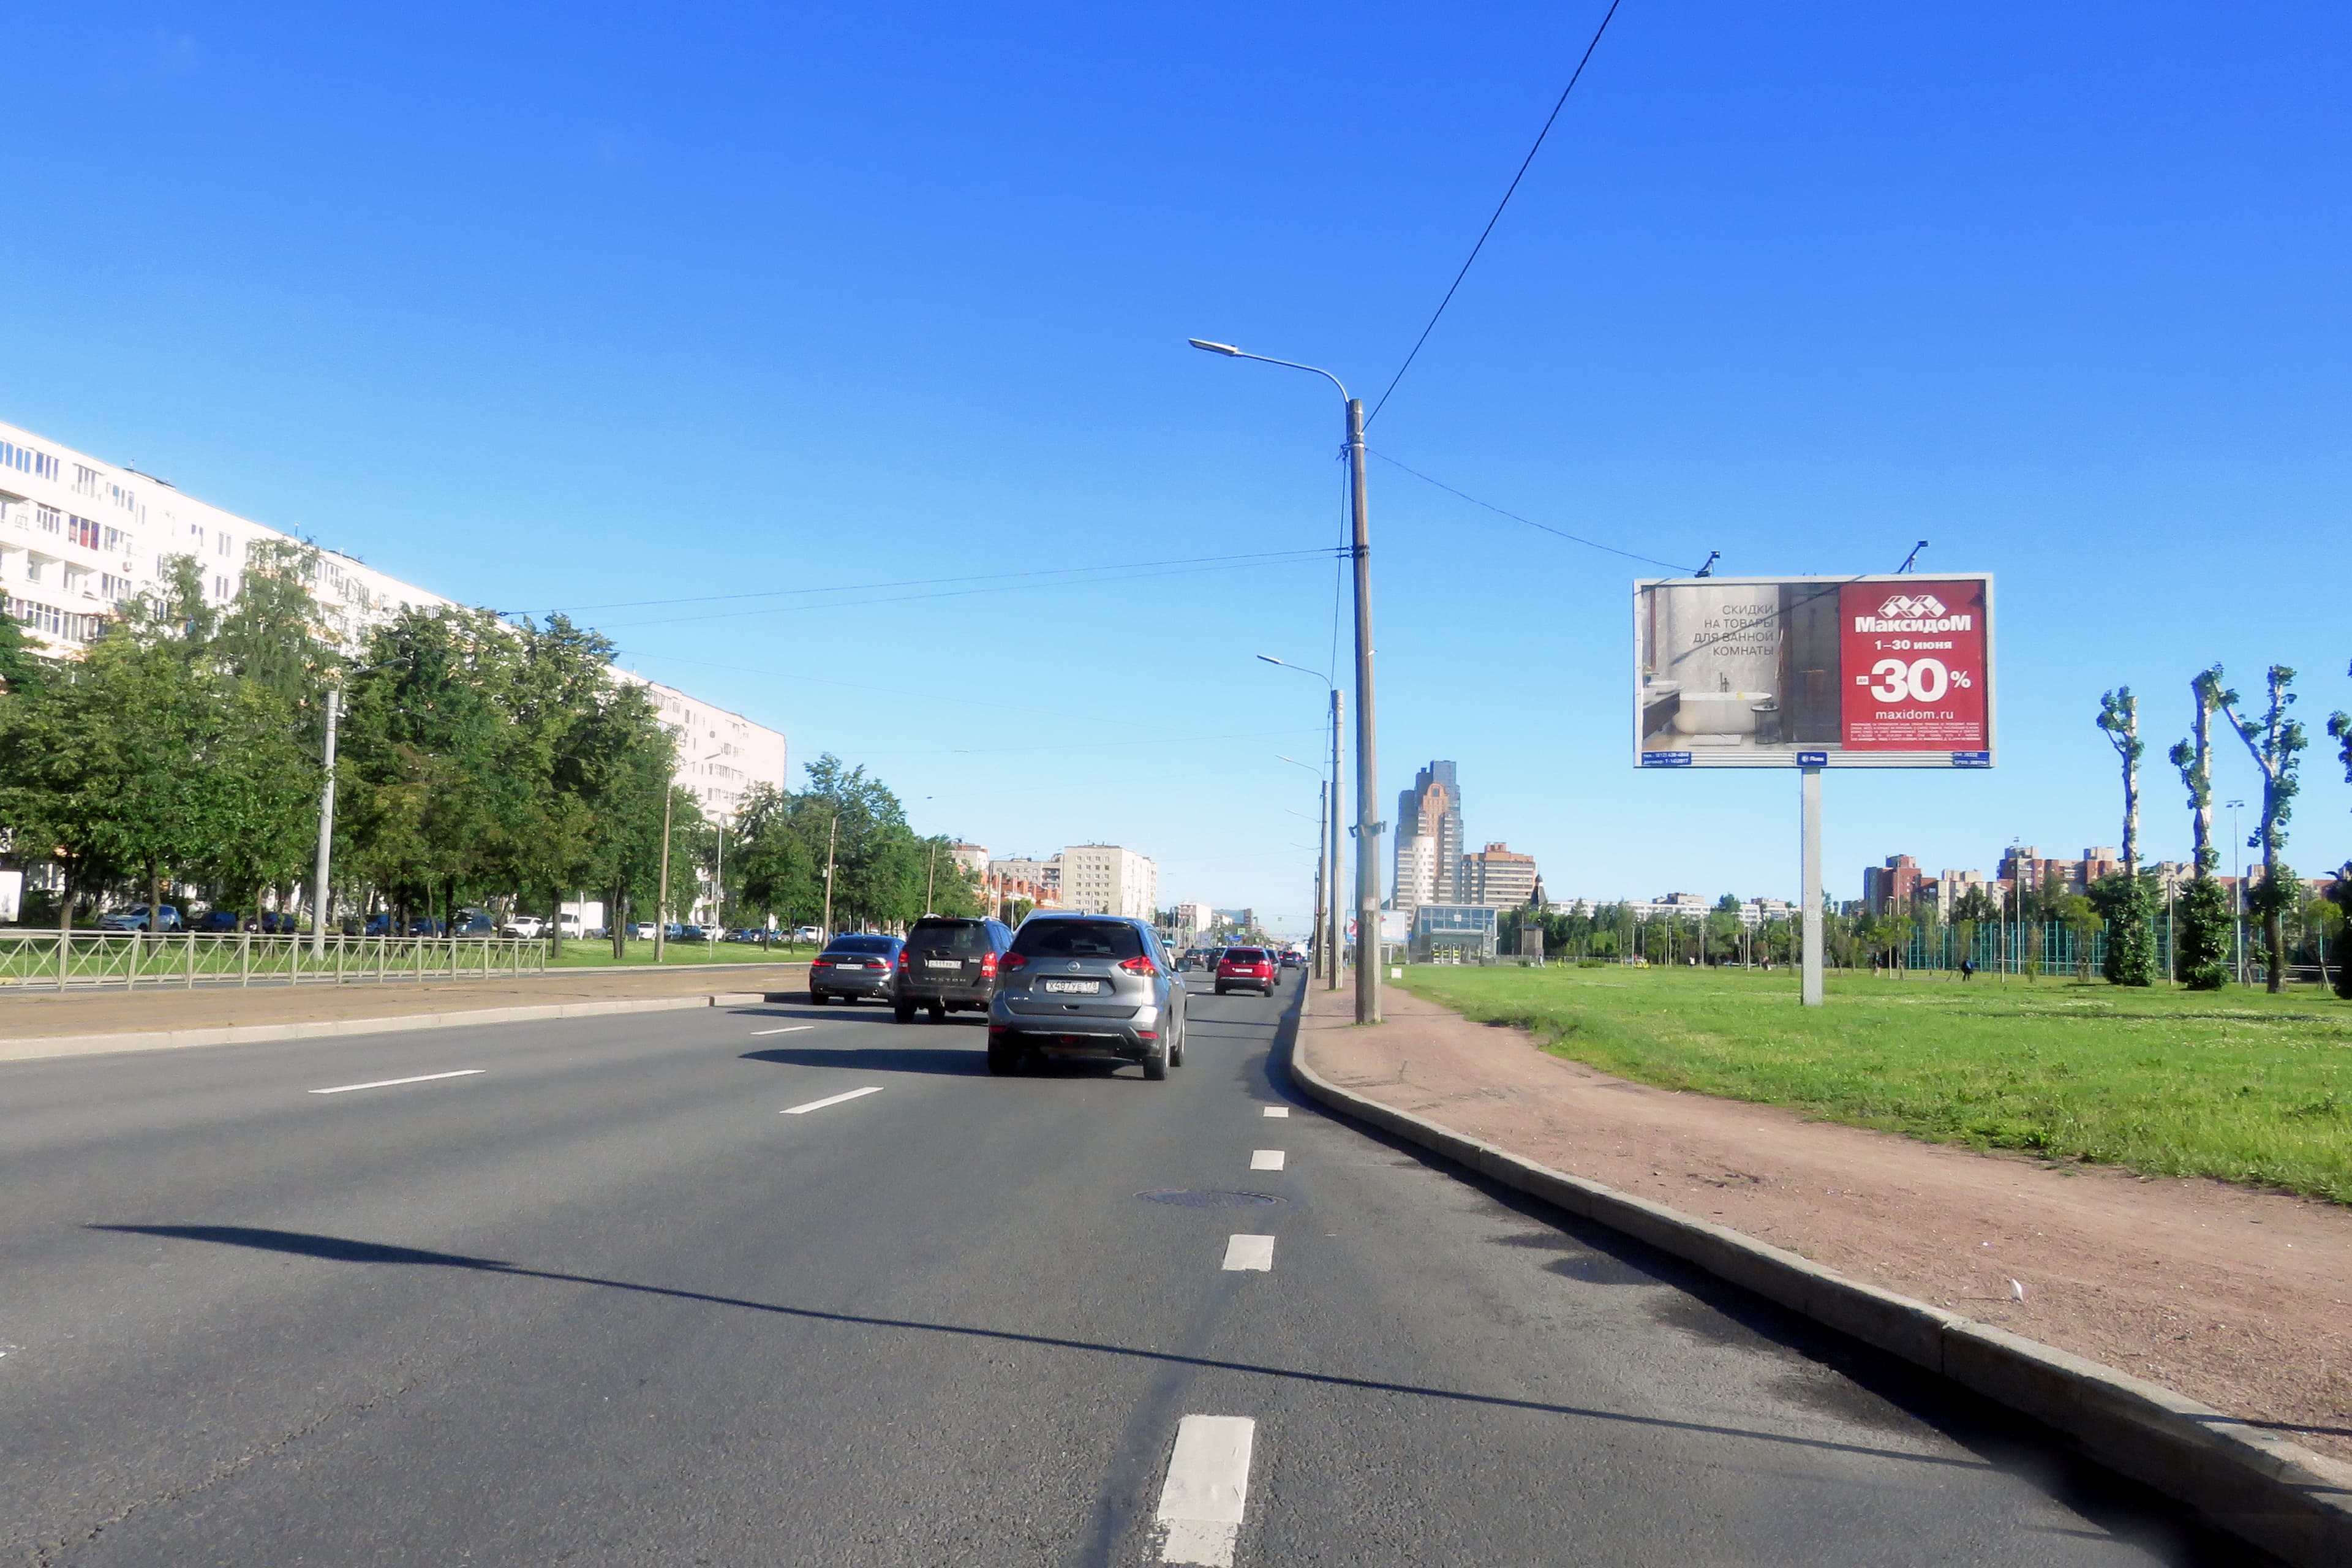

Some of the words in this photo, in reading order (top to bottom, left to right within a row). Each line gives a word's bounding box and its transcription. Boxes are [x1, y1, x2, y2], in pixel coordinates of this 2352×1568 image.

[1722, 605, 1773, 616] СКИДКИ
[1705, 619, 1720, 628] НА
[1724, 619, 1773, 628] ТОВАРЫ
[1855, 615, 1971, 633] МаксидоМ
[1693, 633, 1719, 643] ДЛЯ
[1722, 631, 1774, 643] ВАННОЙ
[1713, 646, 1774, 656] КОМНАТЫ
[1875, 709, 1954, 720] maxidom.ru
